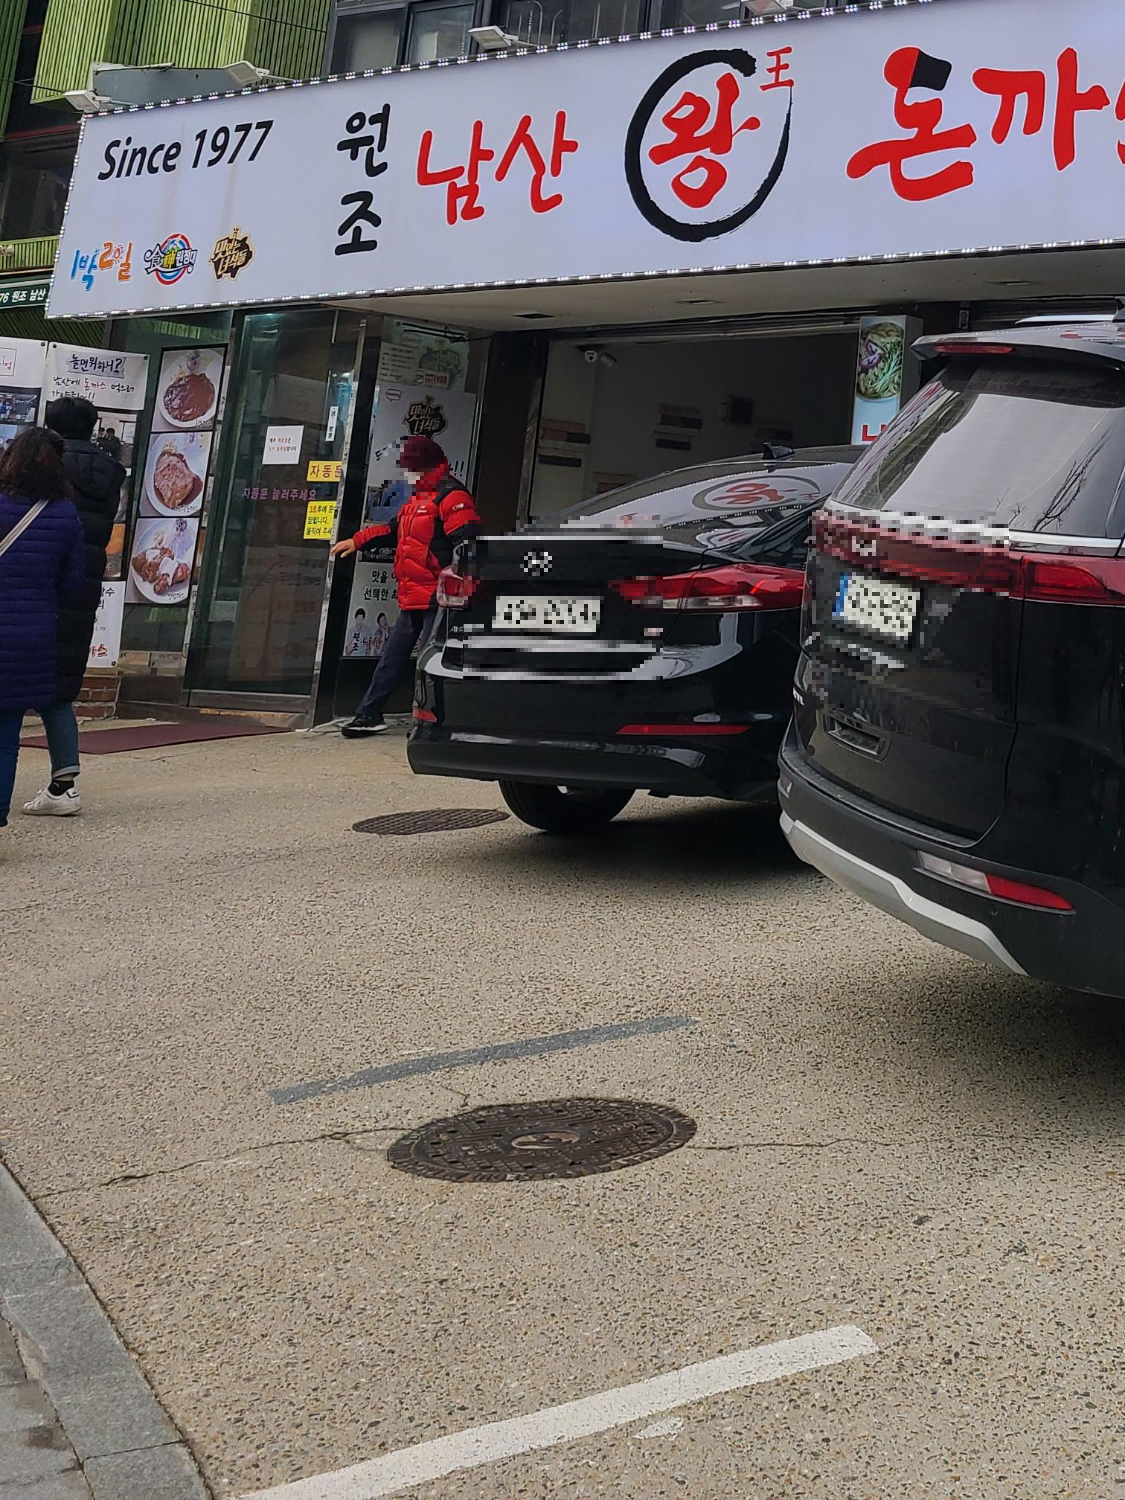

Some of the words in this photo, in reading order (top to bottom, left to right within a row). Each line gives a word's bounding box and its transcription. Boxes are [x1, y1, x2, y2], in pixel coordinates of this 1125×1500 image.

[759, 46, 795, 92] 王
[97, 136, 181, 181] Since
[191, 120, 275, 169] 1977
[416, 110, 580, 225] 남산
[648, 72, 761, 209] 왕
[333, 103, 391, 256] 원조
[70, 241, 132, 291] 1박2일
[11, 290, 28, 303] 원조
[29, 288, 47, 301] 남산
[84, 377, 107, 392] 돈까스
[242, 487, 269, 499] 자동문
[364, 588, 389, 600] 선택한
